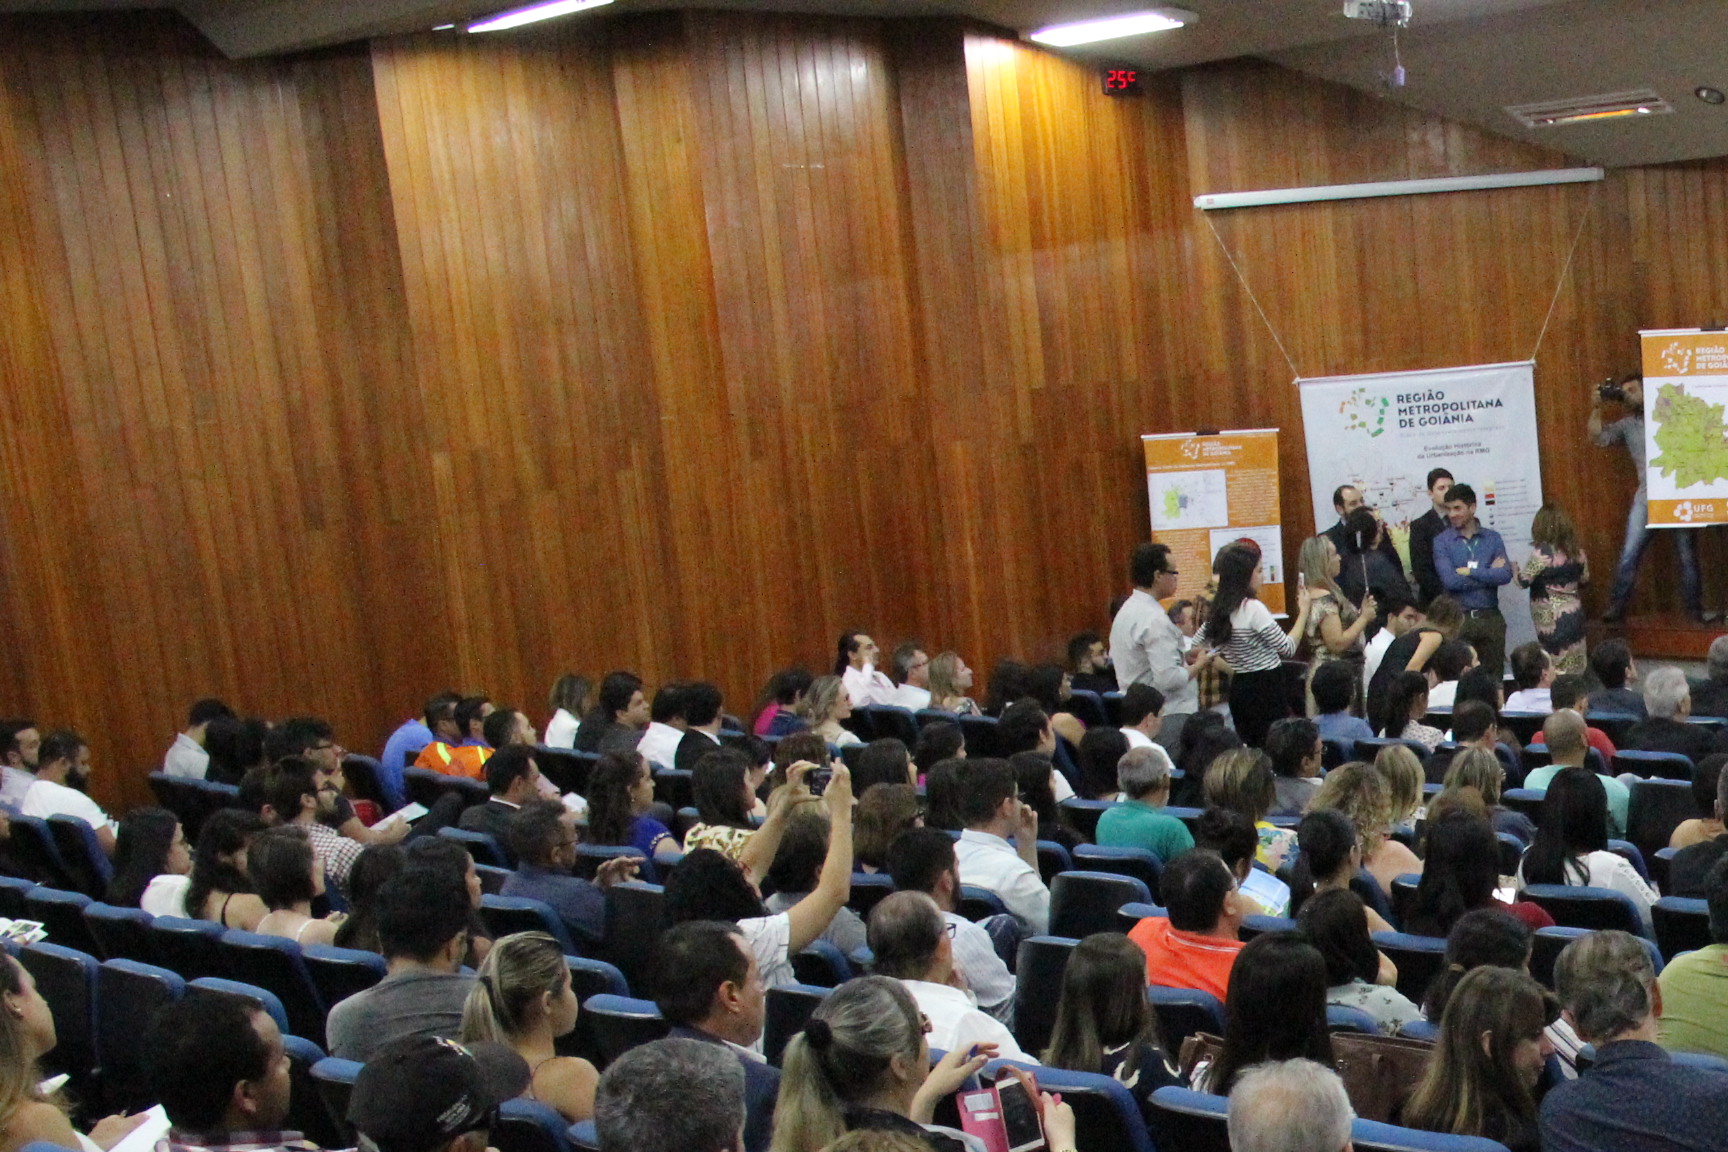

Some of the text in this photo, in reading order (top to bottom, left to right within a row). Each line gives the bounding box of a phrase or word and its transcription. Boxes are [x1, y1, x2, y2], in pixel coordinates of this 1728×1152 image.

[1396, 389, 1445, 404] REGIÃO
[1398, 398, 1504, 416] METROPOLITANA
[1399, 412, 1474, 428] DE GOIÂNIA
[1693, 504, 1714, 513] UFG
